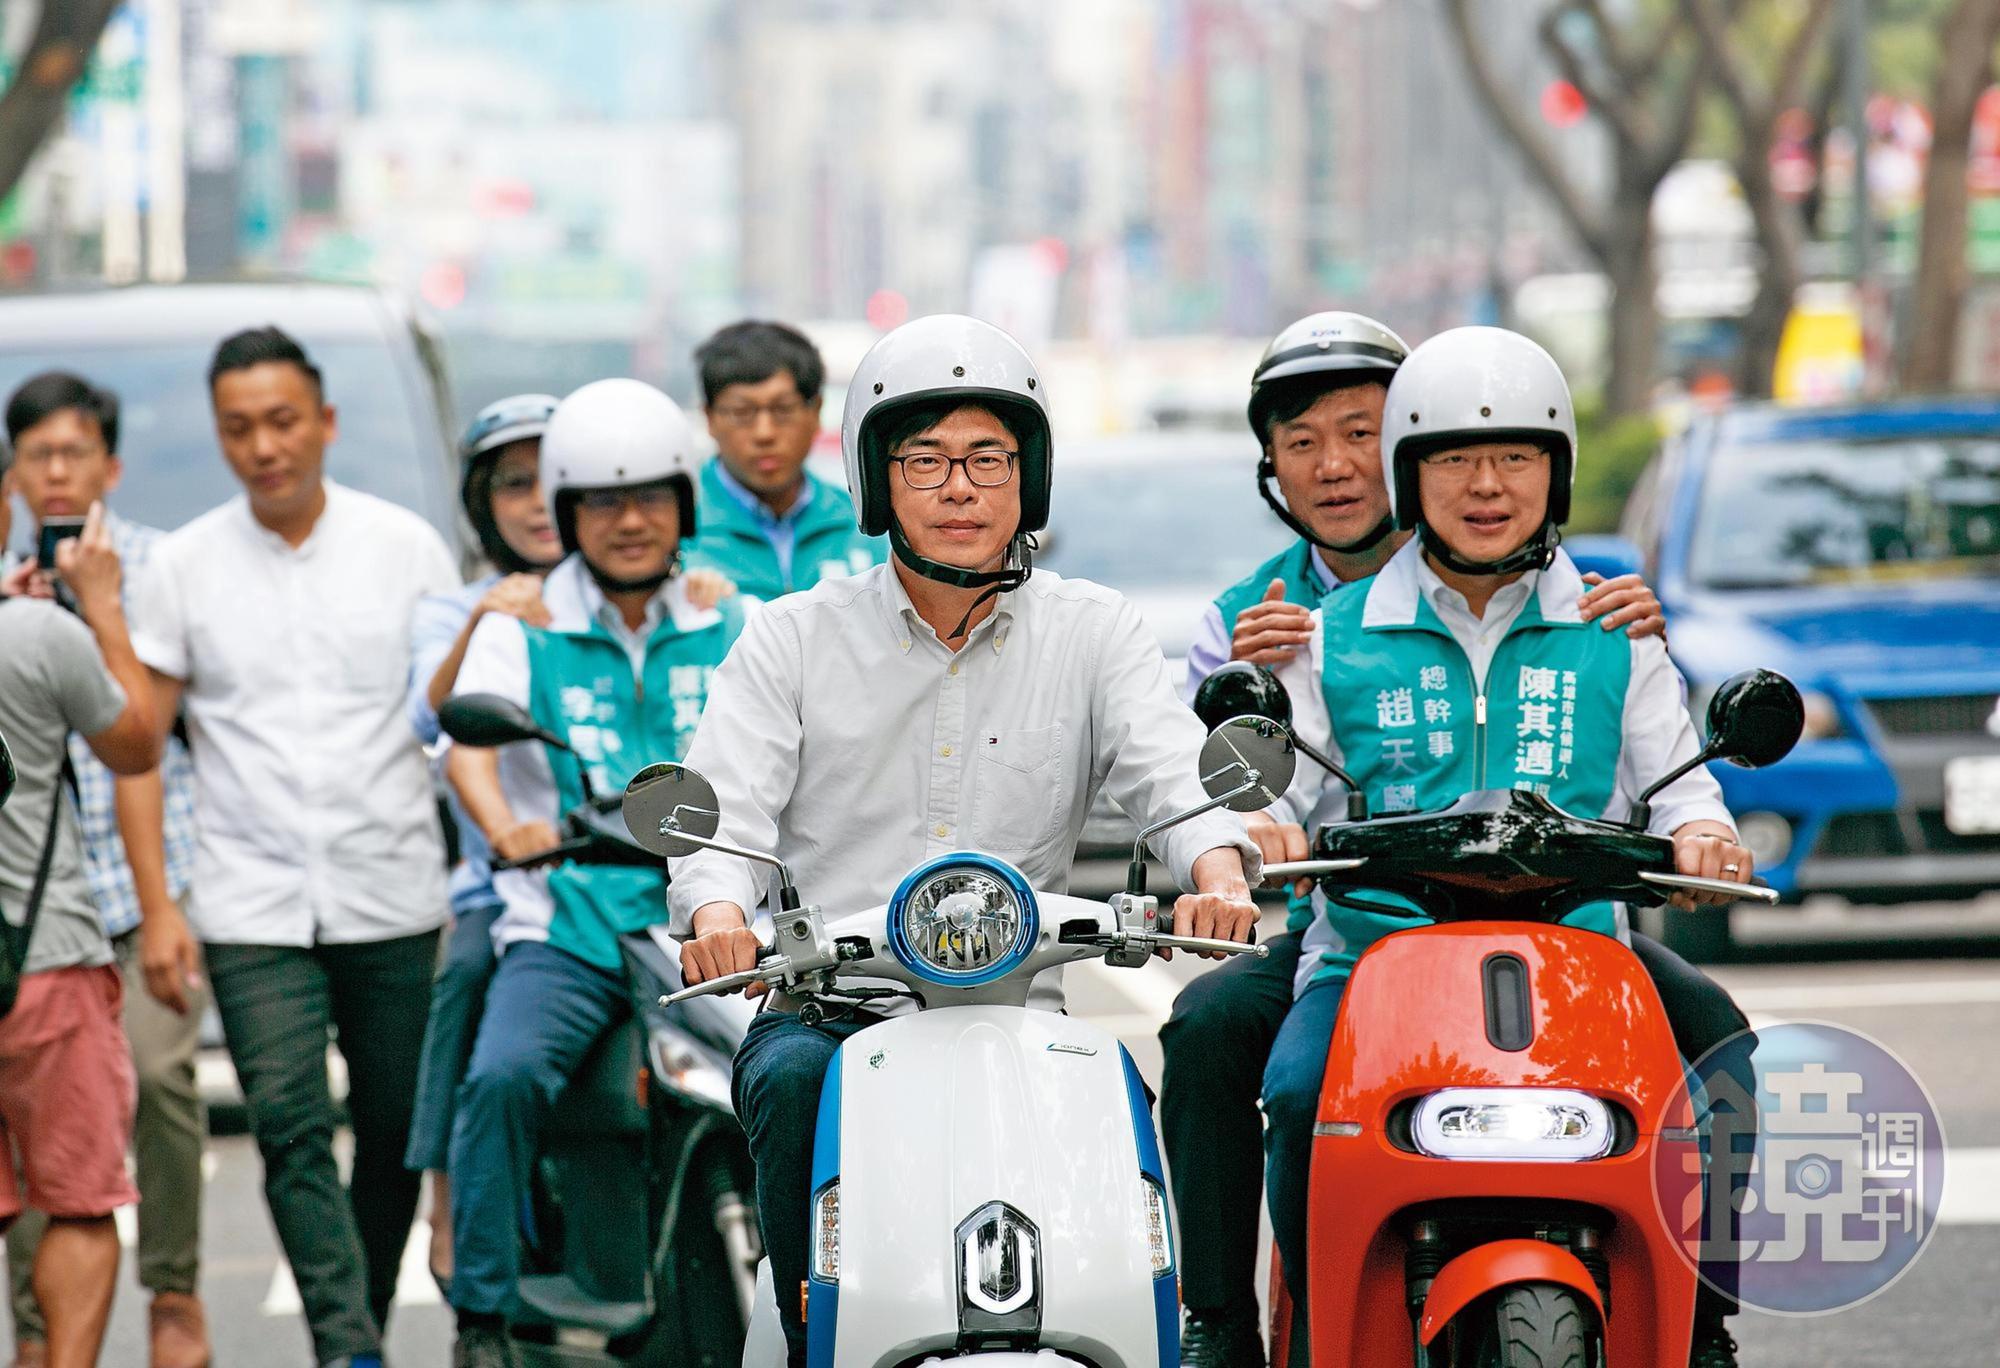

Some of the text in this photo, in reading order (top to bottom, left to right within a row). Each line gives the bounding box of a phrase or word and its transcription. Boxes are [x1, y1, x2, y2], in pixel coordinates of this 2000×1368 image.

[1420, 665, 1454, 758] 總幹事
[1514, 665, 1558, 776] 陳其邁
